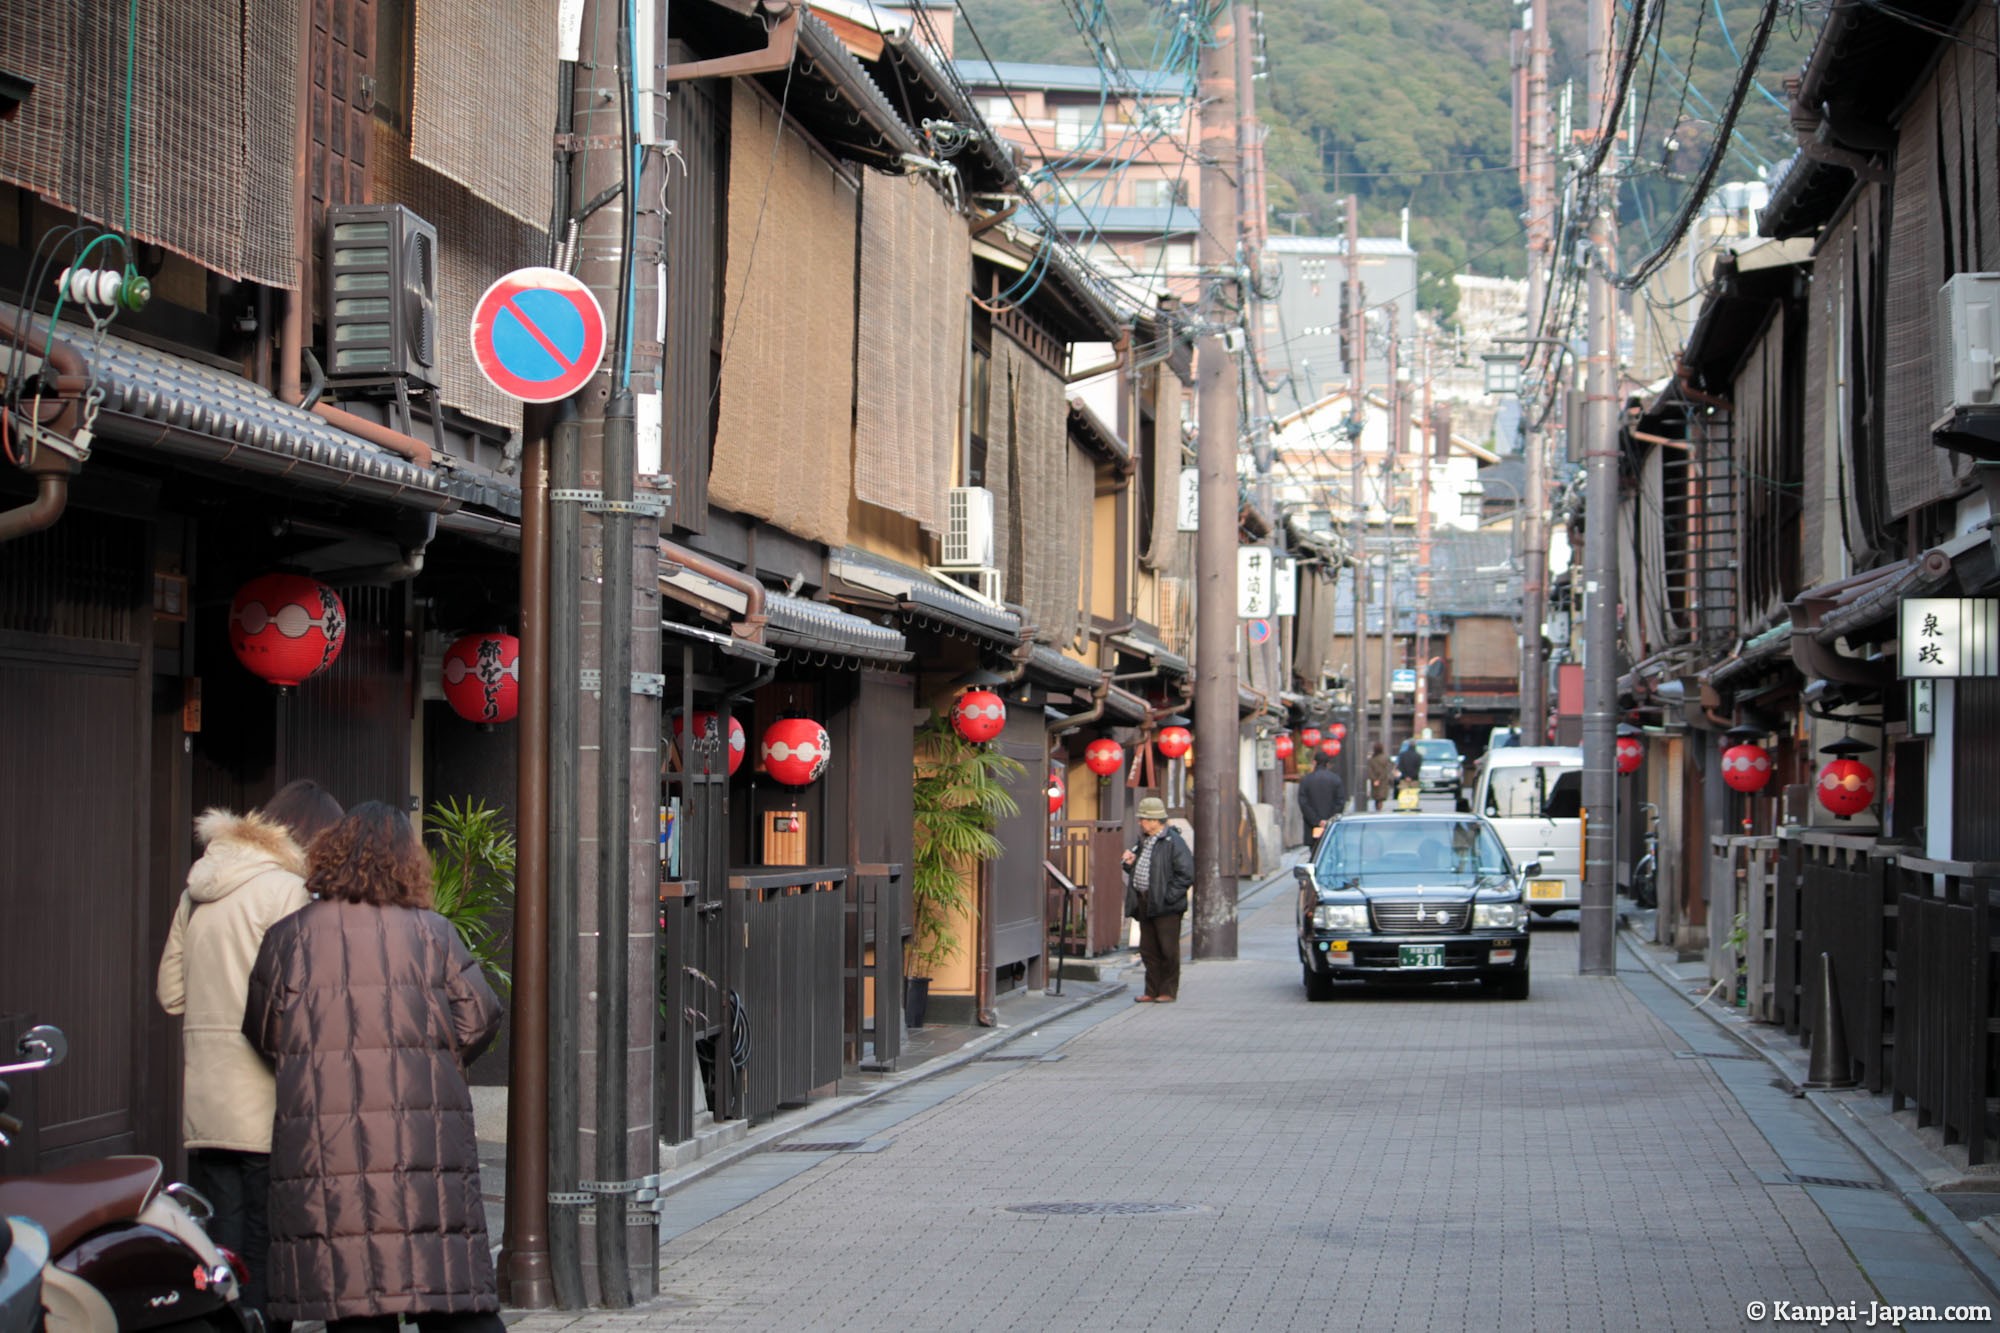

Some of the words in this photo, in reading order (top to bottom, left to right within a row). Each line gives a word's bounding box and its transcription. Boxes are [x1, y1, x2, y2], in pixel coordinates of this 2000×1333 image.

[1919, 613, 1944, 665] 泉政
[478, 639, 503, 720] 都をどり
